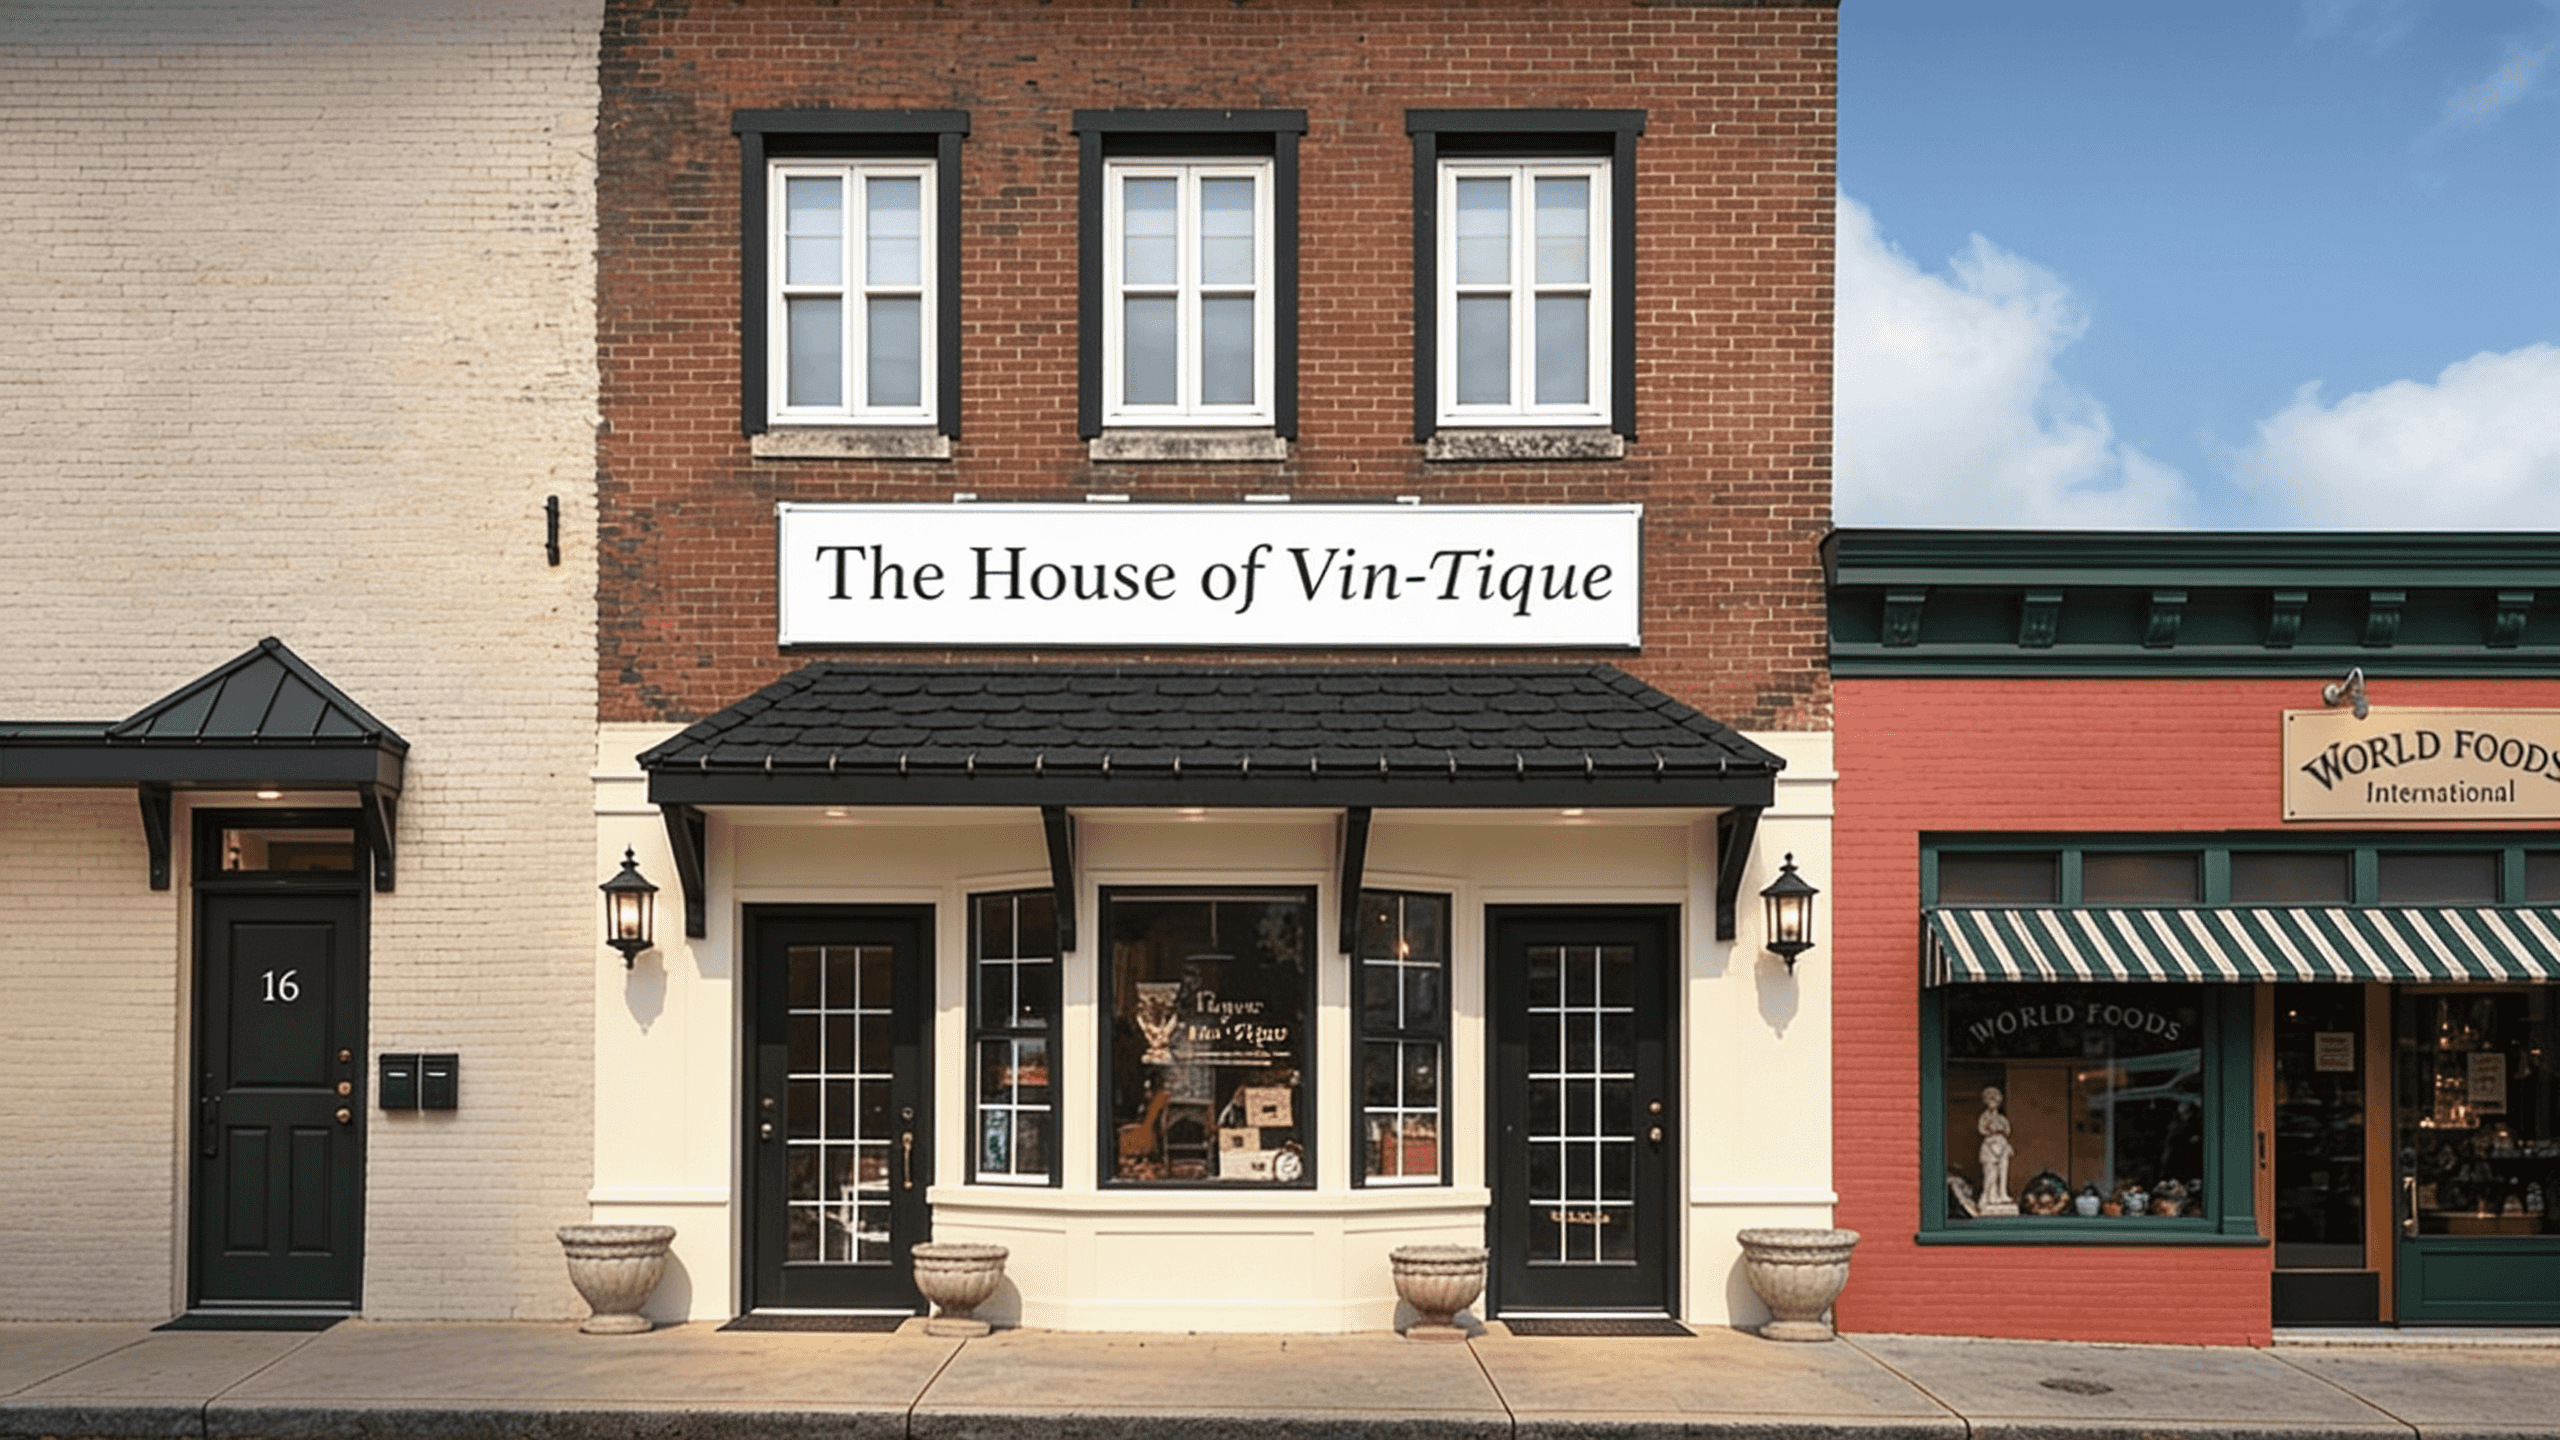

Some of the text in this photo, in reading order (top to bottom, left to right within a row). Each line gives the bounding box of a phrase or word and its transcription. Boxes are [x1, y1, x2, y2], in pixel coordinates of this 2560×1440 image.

[816, 543, 1613, 618] The House of Vin-Tique
[2301, 730, 2442, 791] WORLD
[2367, 779, 2515, 803] International
[262, 969, 300, 1002] 16
[1969, 1004, 2182, 1043] WORLD FOODS
